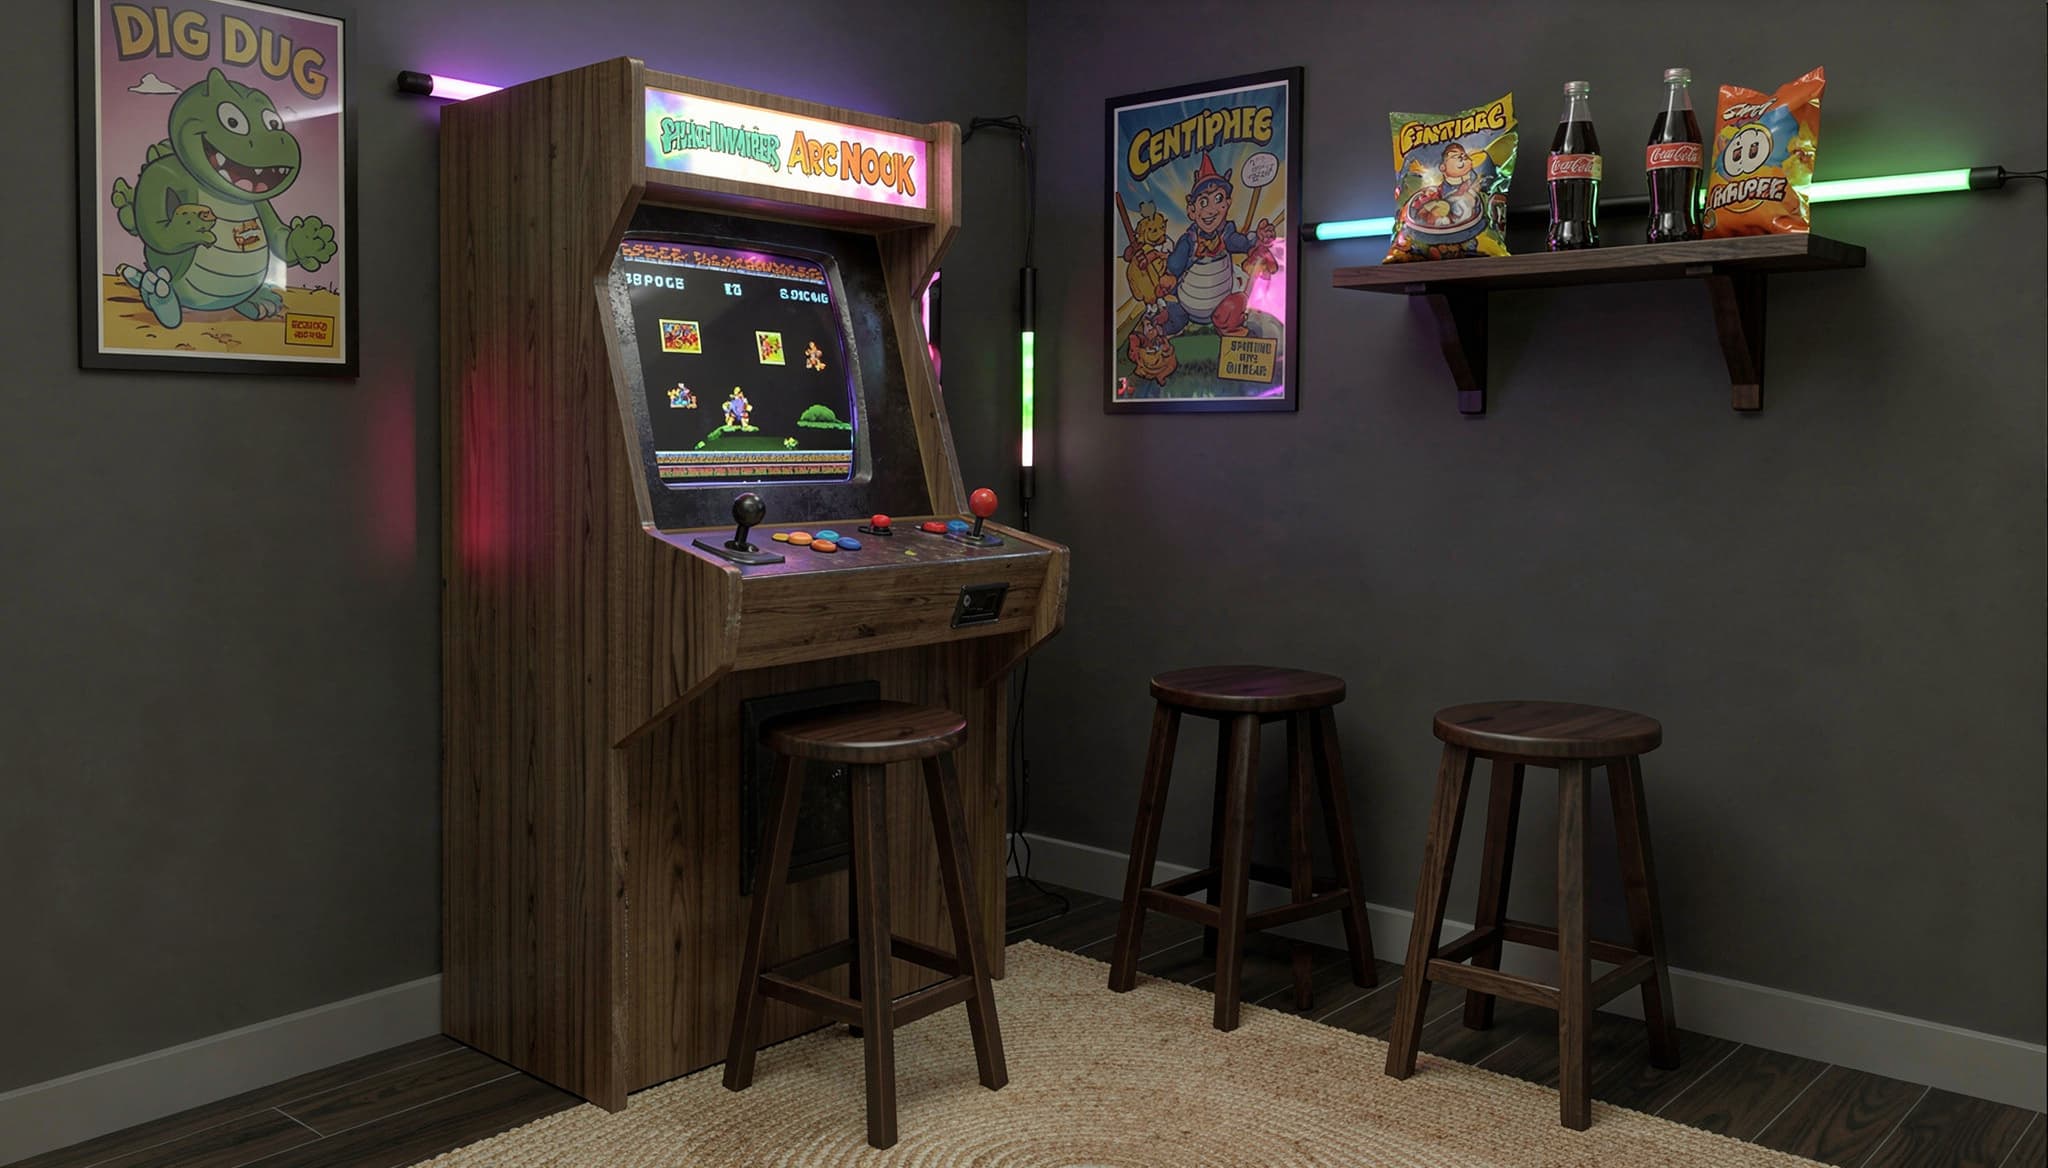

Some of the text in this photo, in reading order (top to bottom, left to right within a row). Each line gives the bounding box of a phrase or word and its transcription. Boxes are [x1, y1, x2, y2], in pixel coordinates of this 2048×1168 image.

[112, 4, 329, 99] DIG DUG
[841, 141, 916, 197] NOOK
